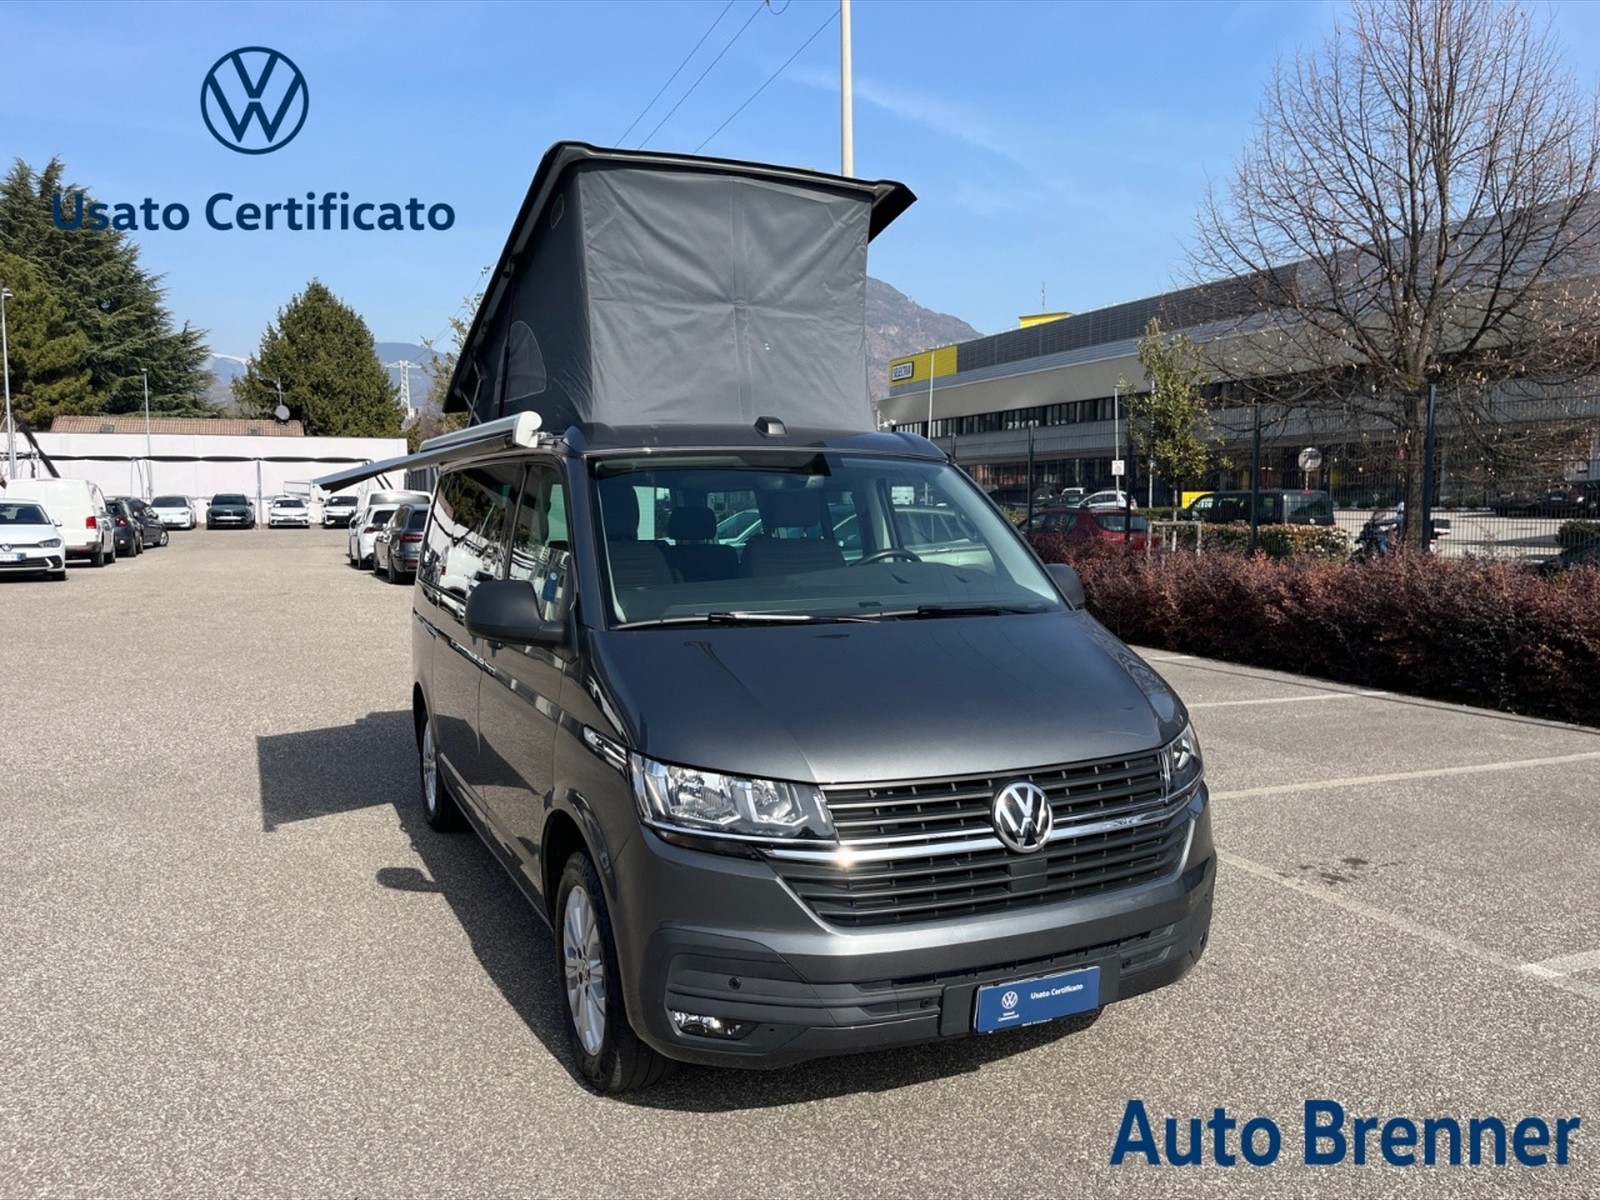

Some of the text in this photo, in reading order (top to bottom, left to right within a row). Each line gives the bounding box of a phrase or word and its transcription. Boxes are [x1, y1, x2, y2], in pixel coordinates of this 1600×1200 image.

[995, 782, 1053, 853] VW
[1030, 984, 1084, 1000] Usato Certificato
